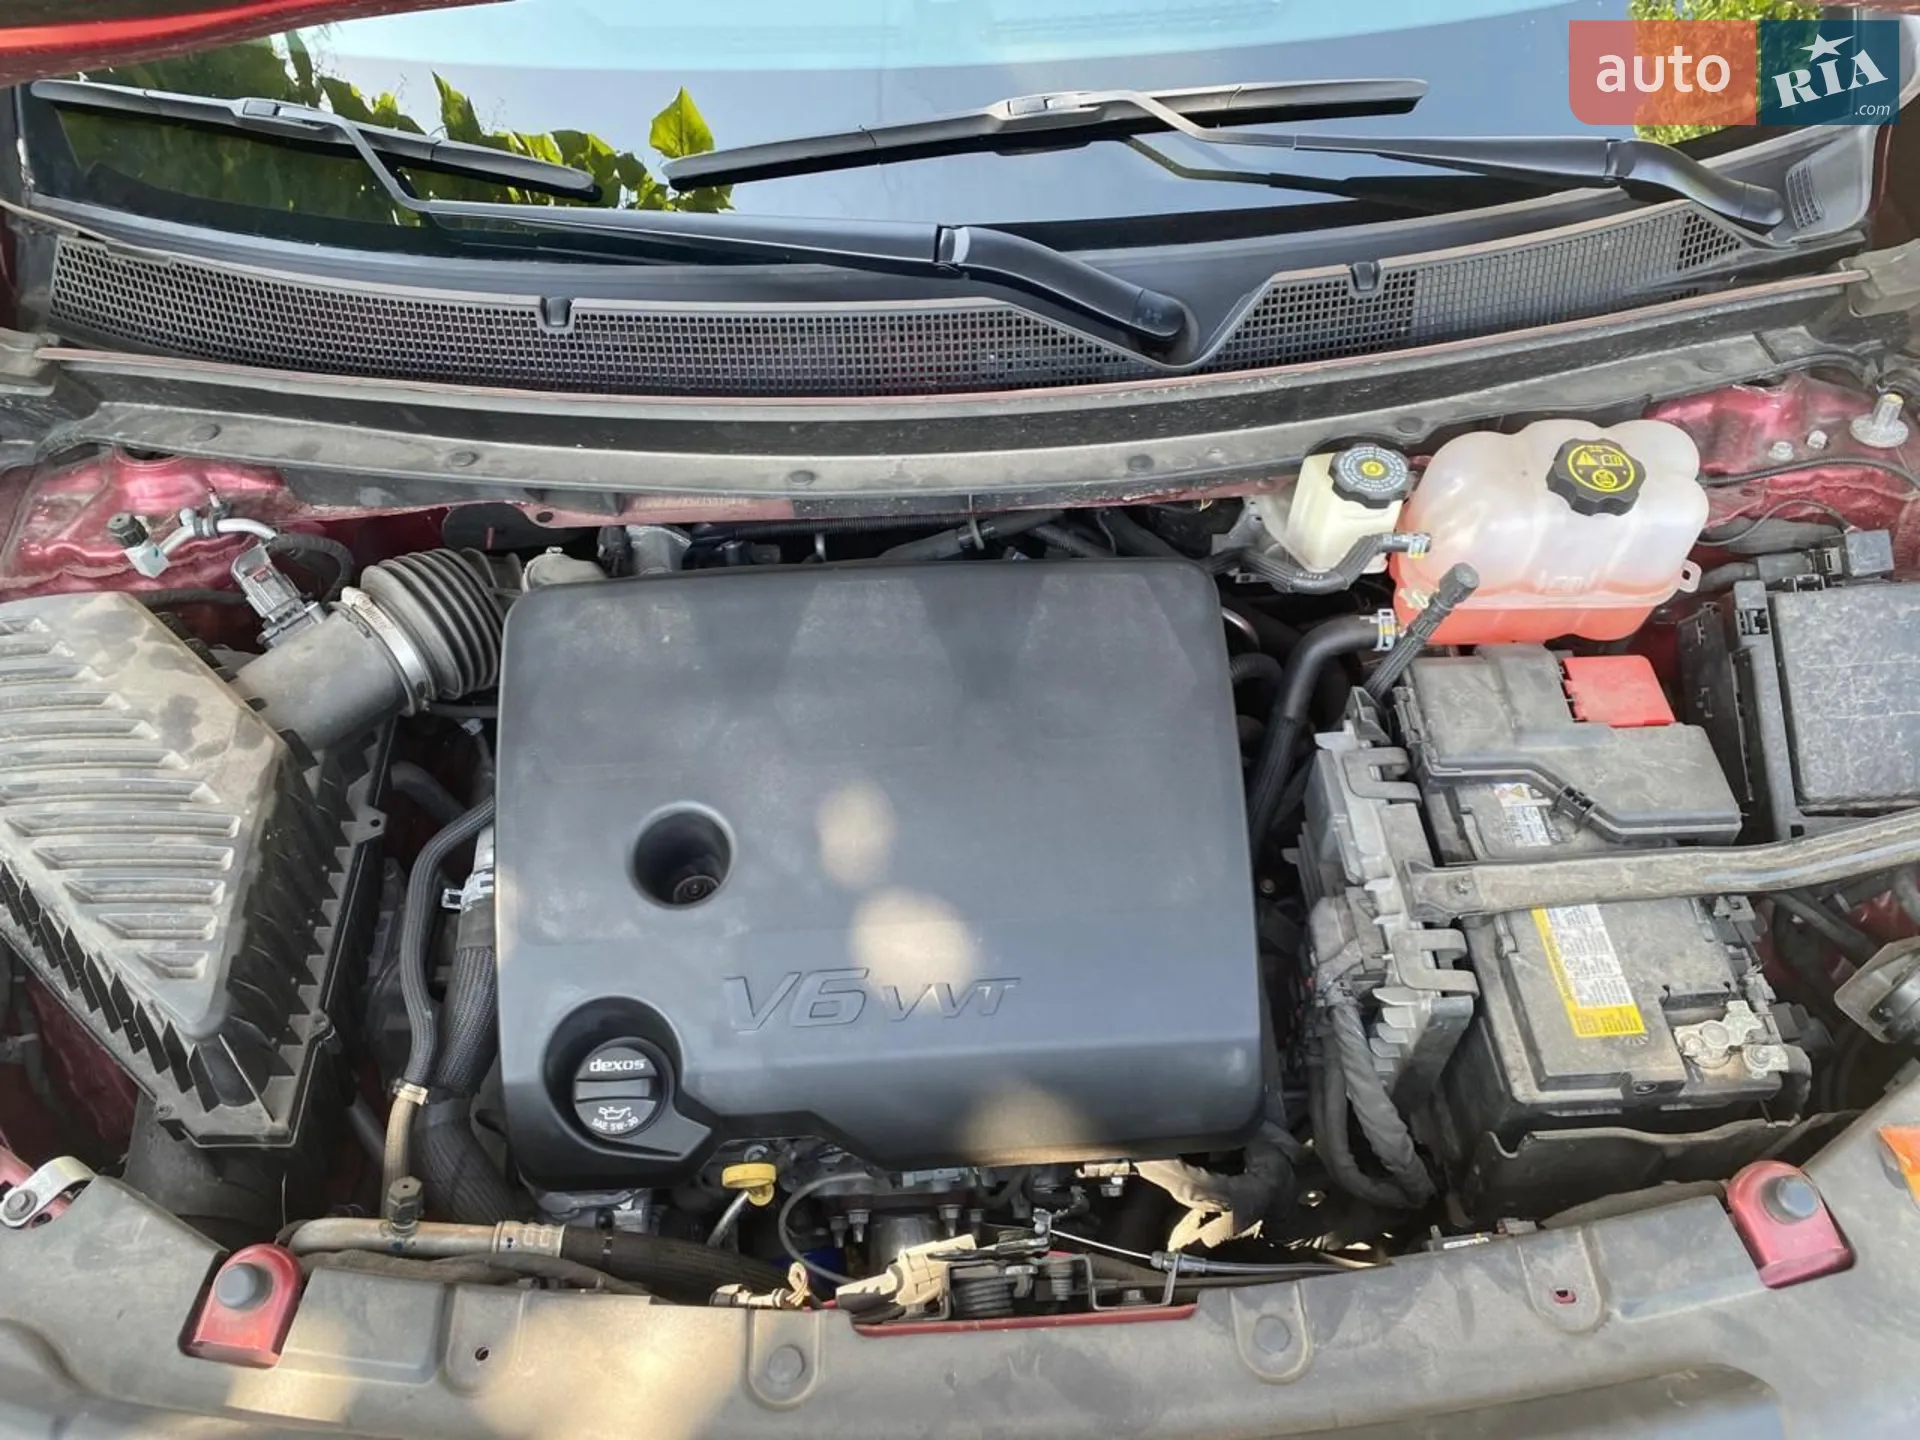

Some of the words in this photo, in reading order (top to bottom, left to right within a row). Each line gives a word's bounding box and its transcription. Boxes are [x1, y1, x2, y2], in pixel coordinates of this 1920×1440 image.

[722, 967, 869, 1034] V6
[589, 1058, 647, 1072] dexos
[592, 1117, 608, 1131] SAE
